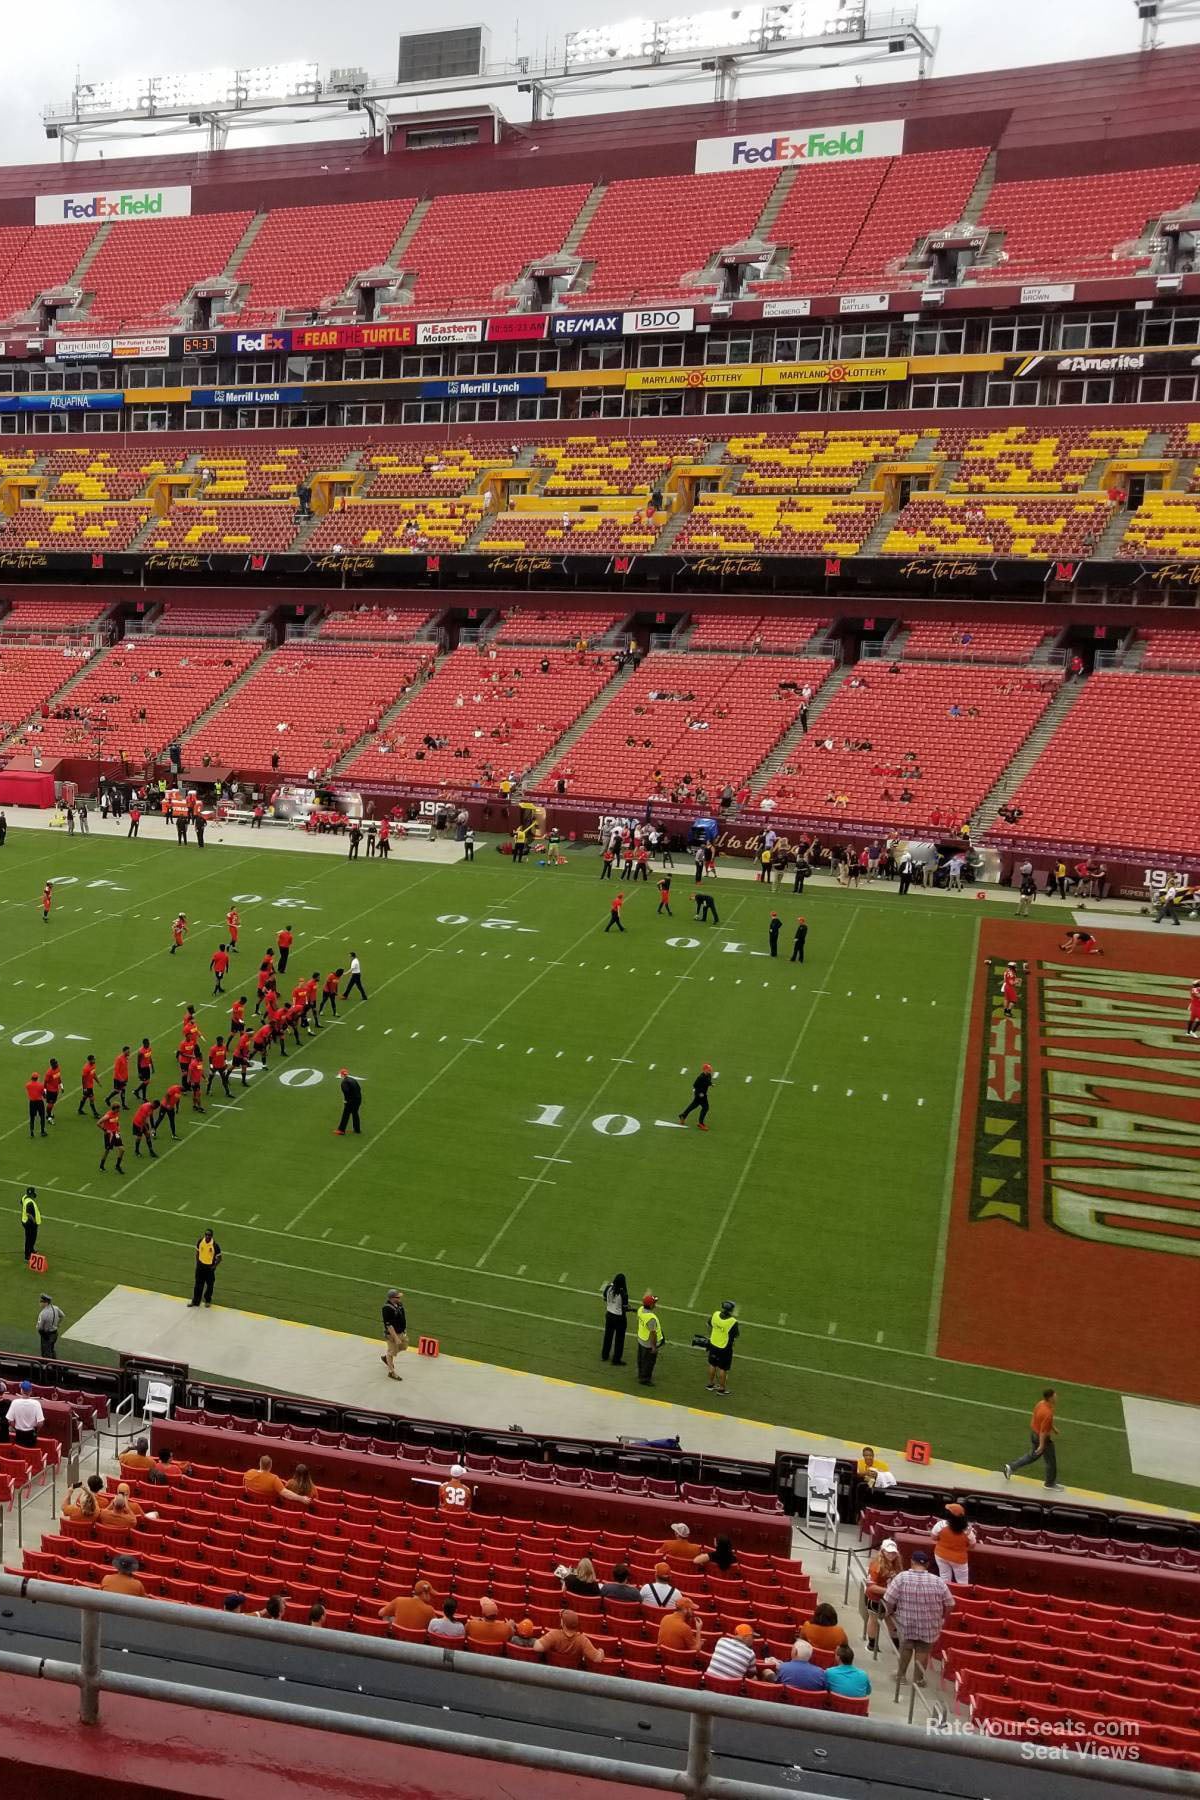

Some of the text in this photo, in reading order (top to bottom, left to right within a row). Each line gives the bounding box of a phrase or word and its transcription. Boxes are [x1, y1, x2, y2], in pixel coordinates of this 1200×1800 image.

[732, 130, 864, 165] FedExField
[64, 193, 162, 219] FedExField
[555, 317, 618, 333] RE/MAX
[640, 312, 680, 327] BDO
[431, 324, 477, 336] Eastern
[237, 333, 284, 352] FedEx
[641, 373, 742, 385] MARYLAND LOTTERY
[779, 368, 887, 379] MARYLAND LOTTERY
[225, 390, 280, 402] Merrill Lynch
[460, 382, 520, 394] Merrill Lynch
[527, 1103, 642, 1137] 10
[30, 1255, 44, 1271] 20
[420, 1339, 436, 1356] 10
[911, 1445, 926, 1462] G
[445, 1487, 466, 1506] 32
